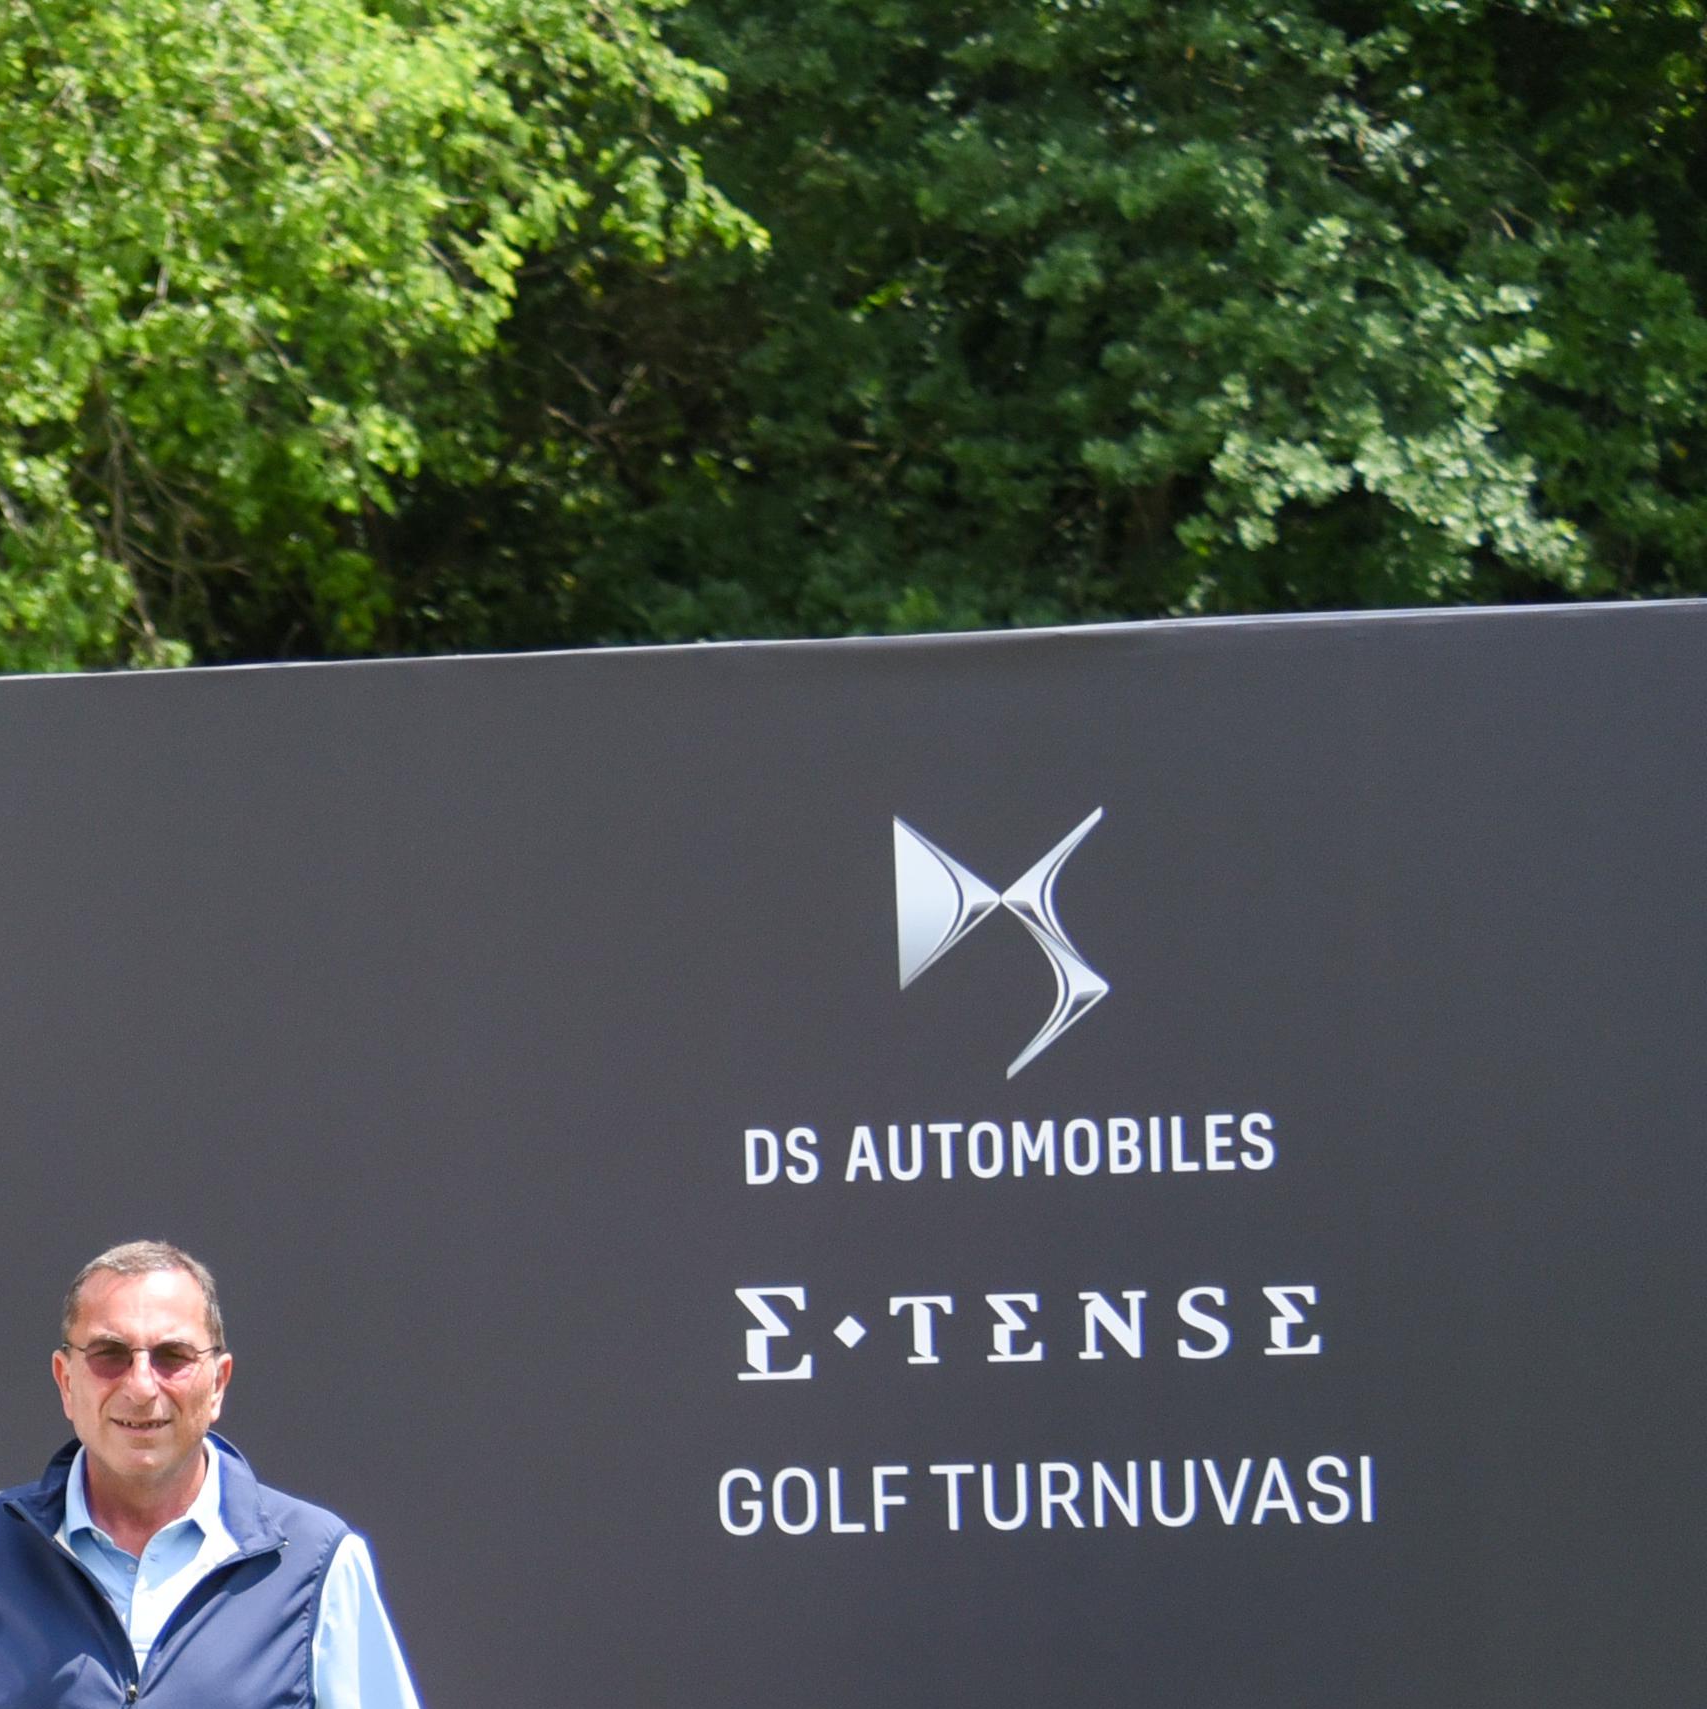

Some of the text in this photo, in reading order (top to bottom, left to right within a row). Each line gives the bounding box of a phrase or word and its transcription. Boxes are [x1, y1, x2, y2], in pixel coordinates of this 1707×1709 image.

[743, 1112, 1276, 1186] DS AUTOMOBILES
[717, 1454, 1374, 1537] GOLF TURNUVASI
